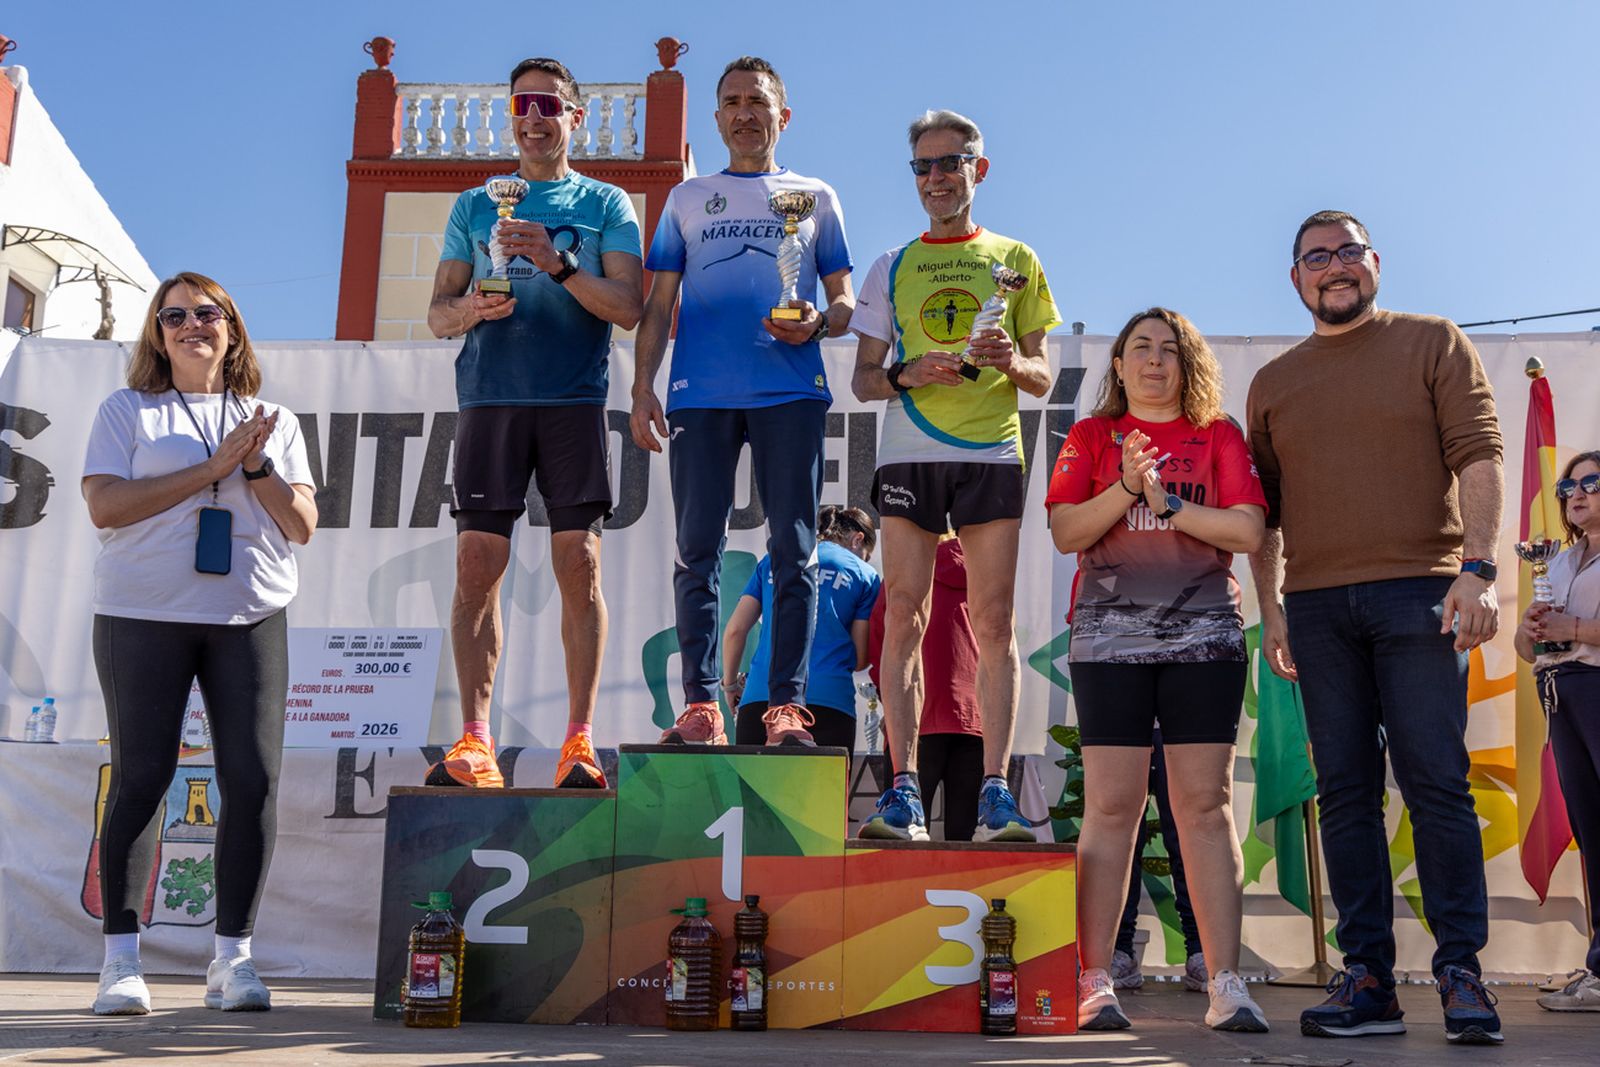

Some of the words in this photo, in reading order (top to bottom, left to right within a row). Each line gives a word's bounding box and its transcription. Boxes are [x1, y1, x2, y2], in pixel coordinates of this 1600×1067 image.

[701, 224, 787, 242] MARACEN
[917, 260, 953, 273] Miguel
[956, 258, 987, 270] Ángel
[354, 662, 400, 676] 300,00
[403, 662, 412, 674] €
[291, 682, 322, 694] RÉCORD
[322, 684, 333, 694] DE
[333, 684, 345, 694] LA
[344, 684, 375, 694] PRUEBA
[298, 712, 309, 721] LA
[310, 712, 350, 722] GANADORA
[330, 730, 356, 739] MARTOS
[361, 722, 399, 736] 2026
[704, 806, 745, 902] 1
[463, 848, 530, 946] 2
[924, 889, 990, 986] 3
[767, 981, 836, 992] EPORTES
